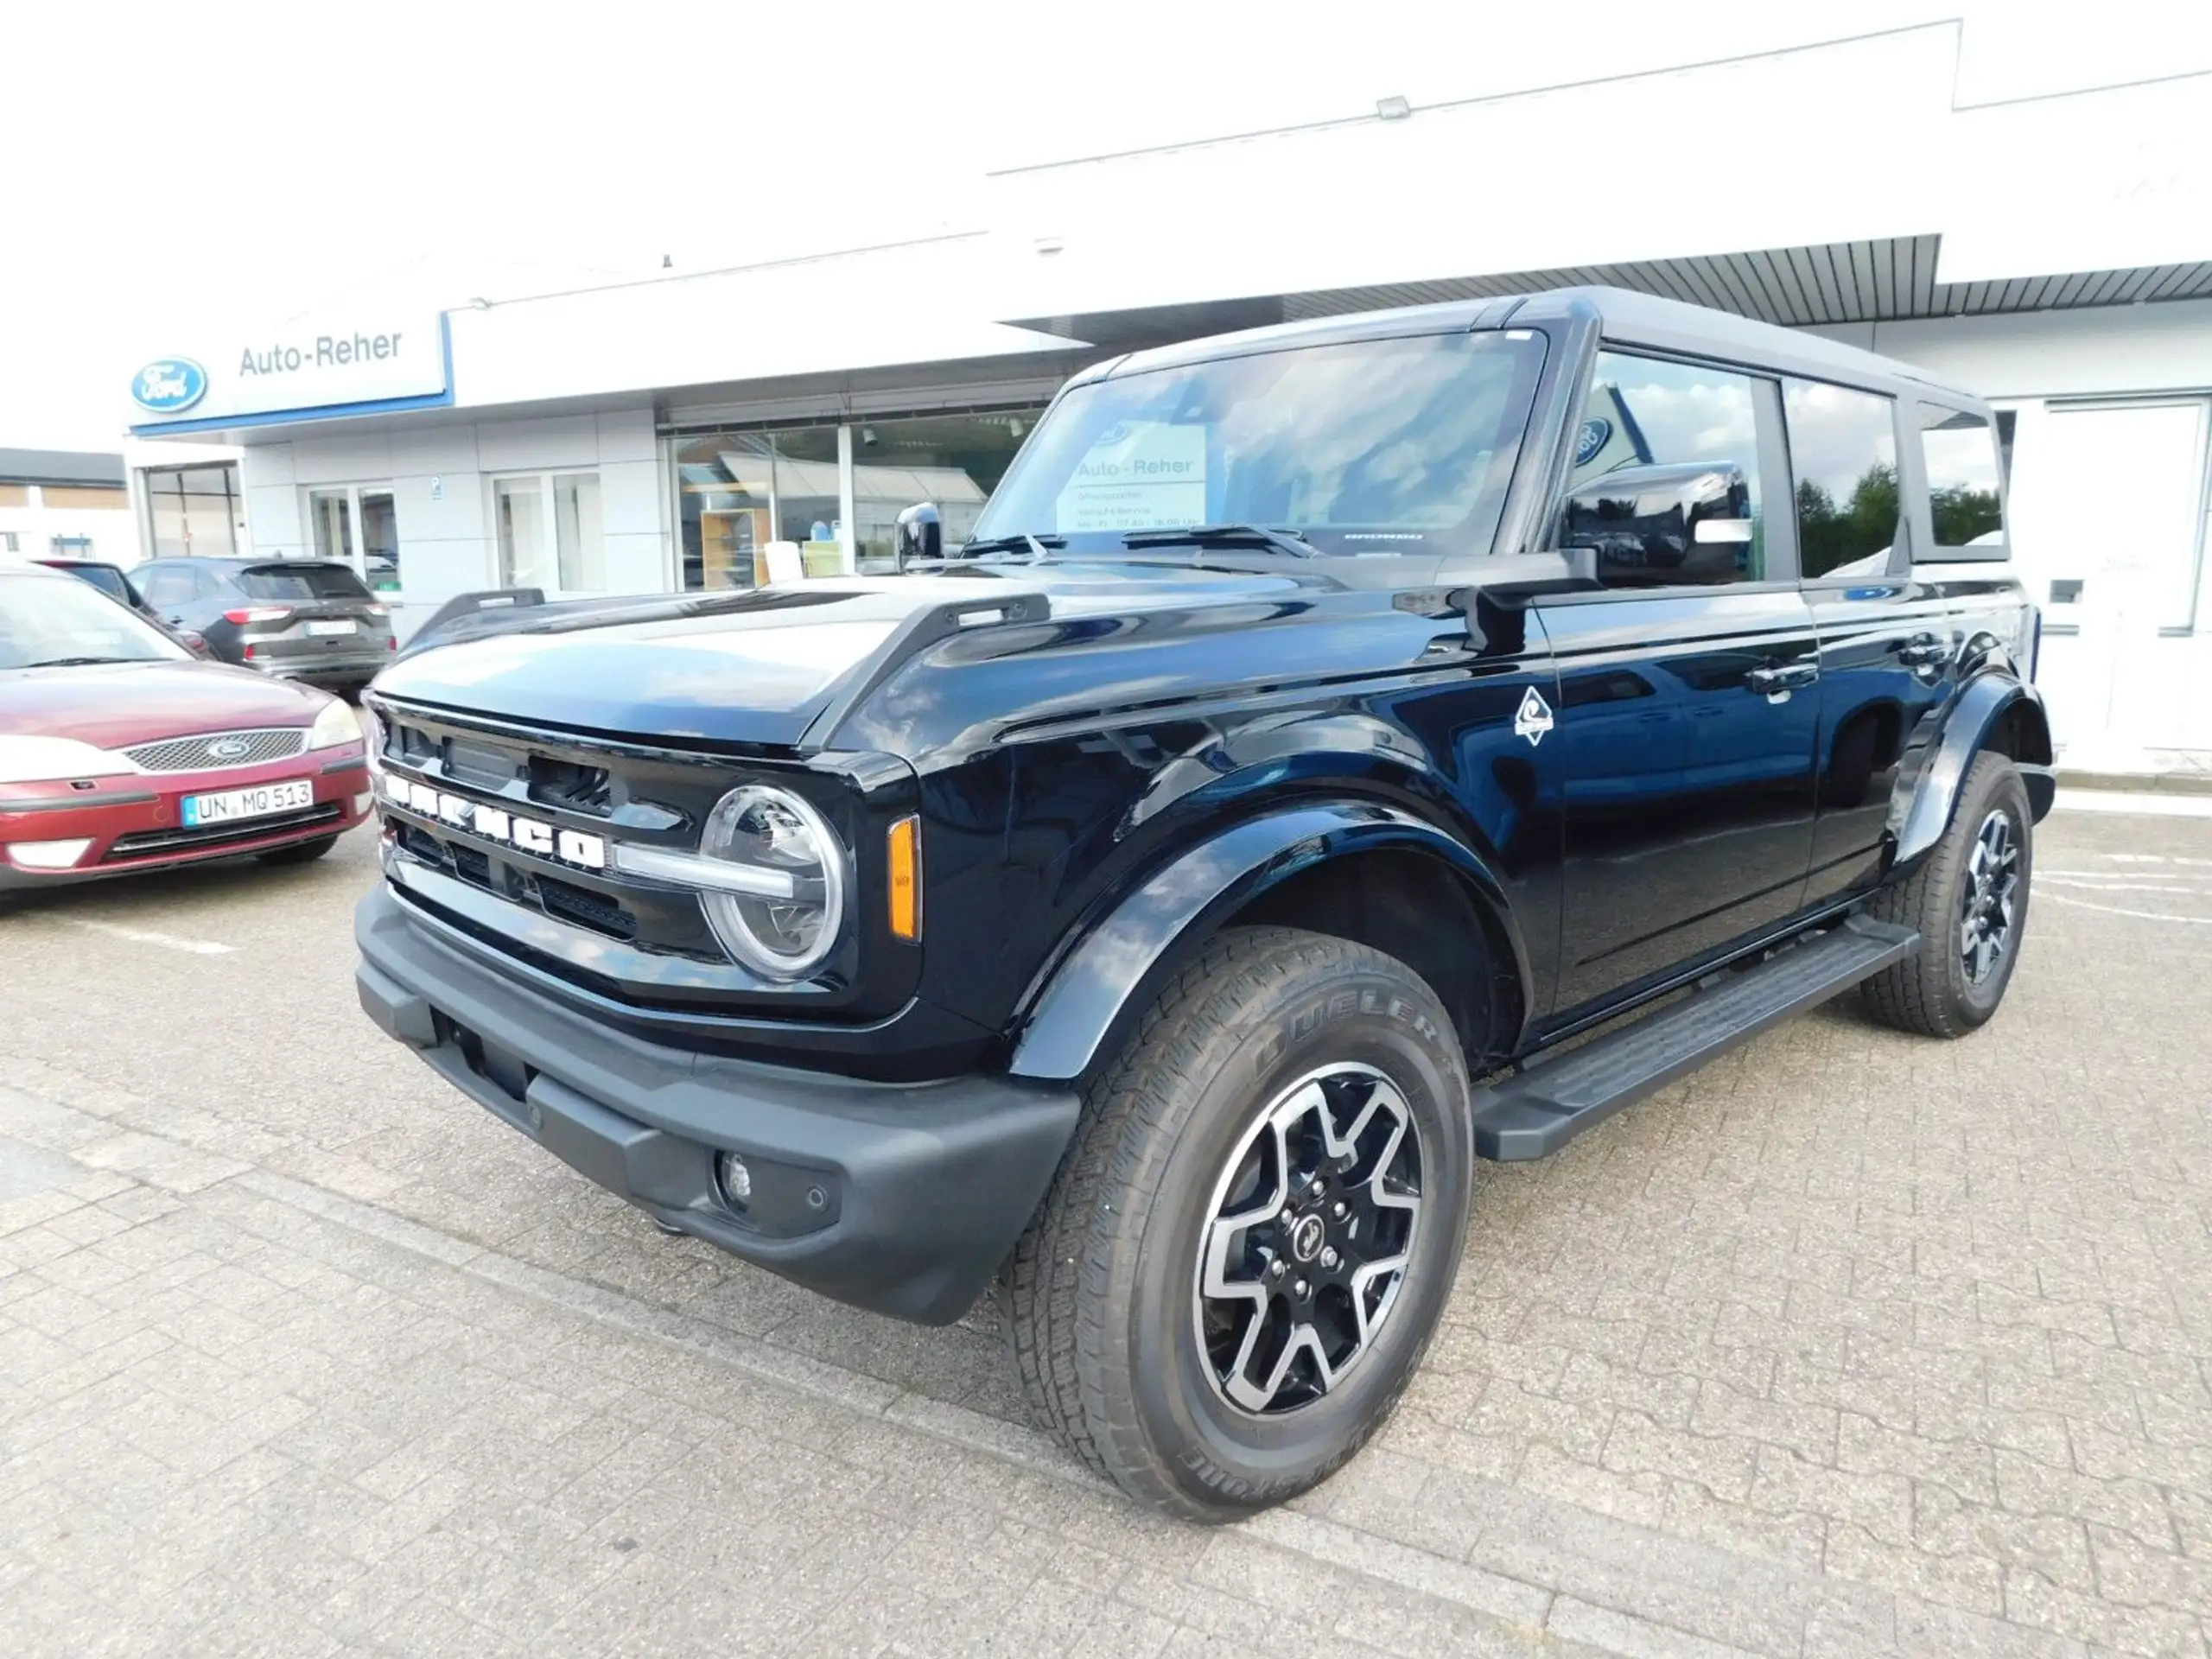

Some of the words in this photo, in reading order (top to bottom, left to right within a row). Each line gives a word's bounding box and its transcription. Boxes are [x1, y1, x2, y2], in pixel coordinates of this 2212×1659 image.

[239, 332, 402, 376] Auto-Reher
[141, 365, 188, 401] Ford
[1078, 461, 1119, 477] Auto
[1134, 459, 1194, 475] Reher
[199, 796, 227, 818] UN
[273, 785, 309, 807] 513
[1255, 989, 1438, 1080] DUELER
